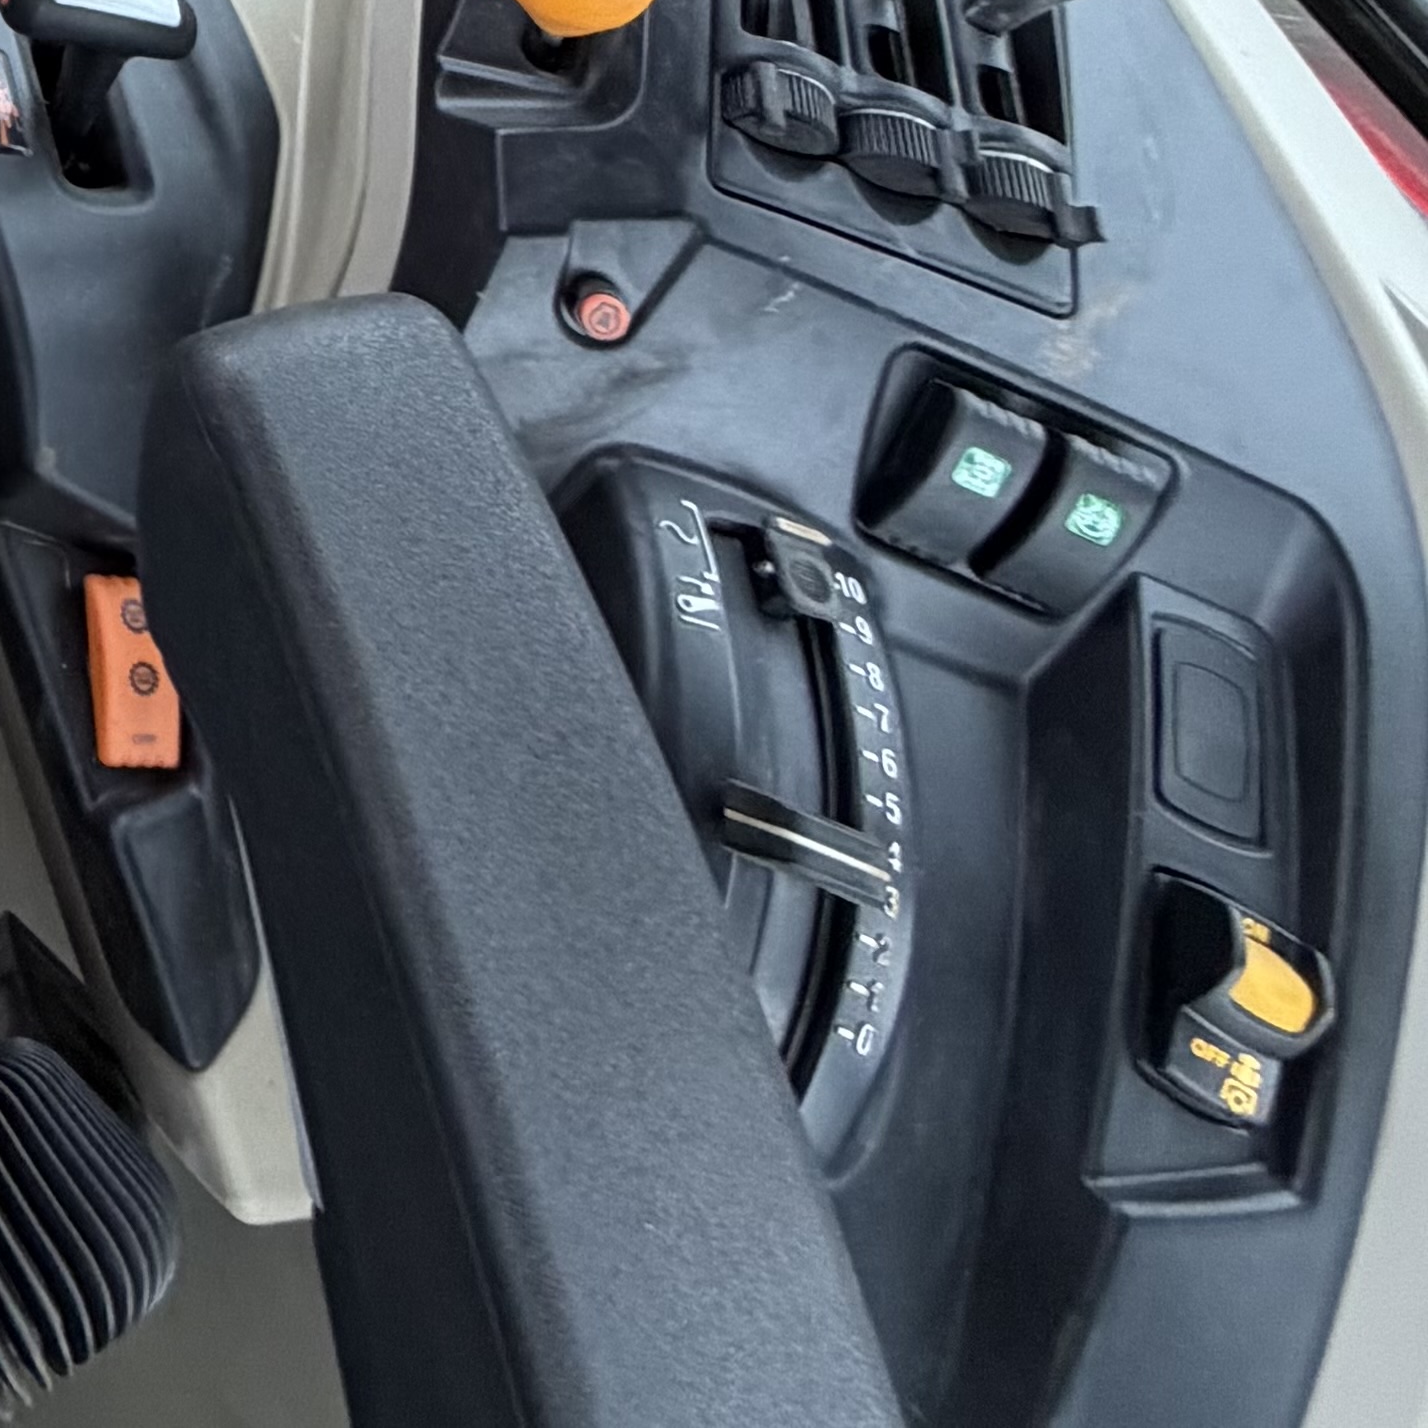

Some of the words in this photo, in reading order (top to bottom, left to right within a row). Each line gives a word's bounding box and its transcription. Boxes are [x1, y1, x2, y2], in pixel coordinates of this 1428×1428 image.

[835, 572, 867, 605] 10
[855, 616, 873, 645] 9
[866, 662, 884, 692] 8
[874, 703, 891, 733] 7
[882, 748, 897, 778] 6
[885, 792, 902, 825] 5
[883, 886, 900, 920] 3
[875, 933, 892, 966] 2
[870, 980, 885, 1012] 1
[856, 1024, 877, 1056] 0
[1190, 1037, 1231, 1069] OFF
